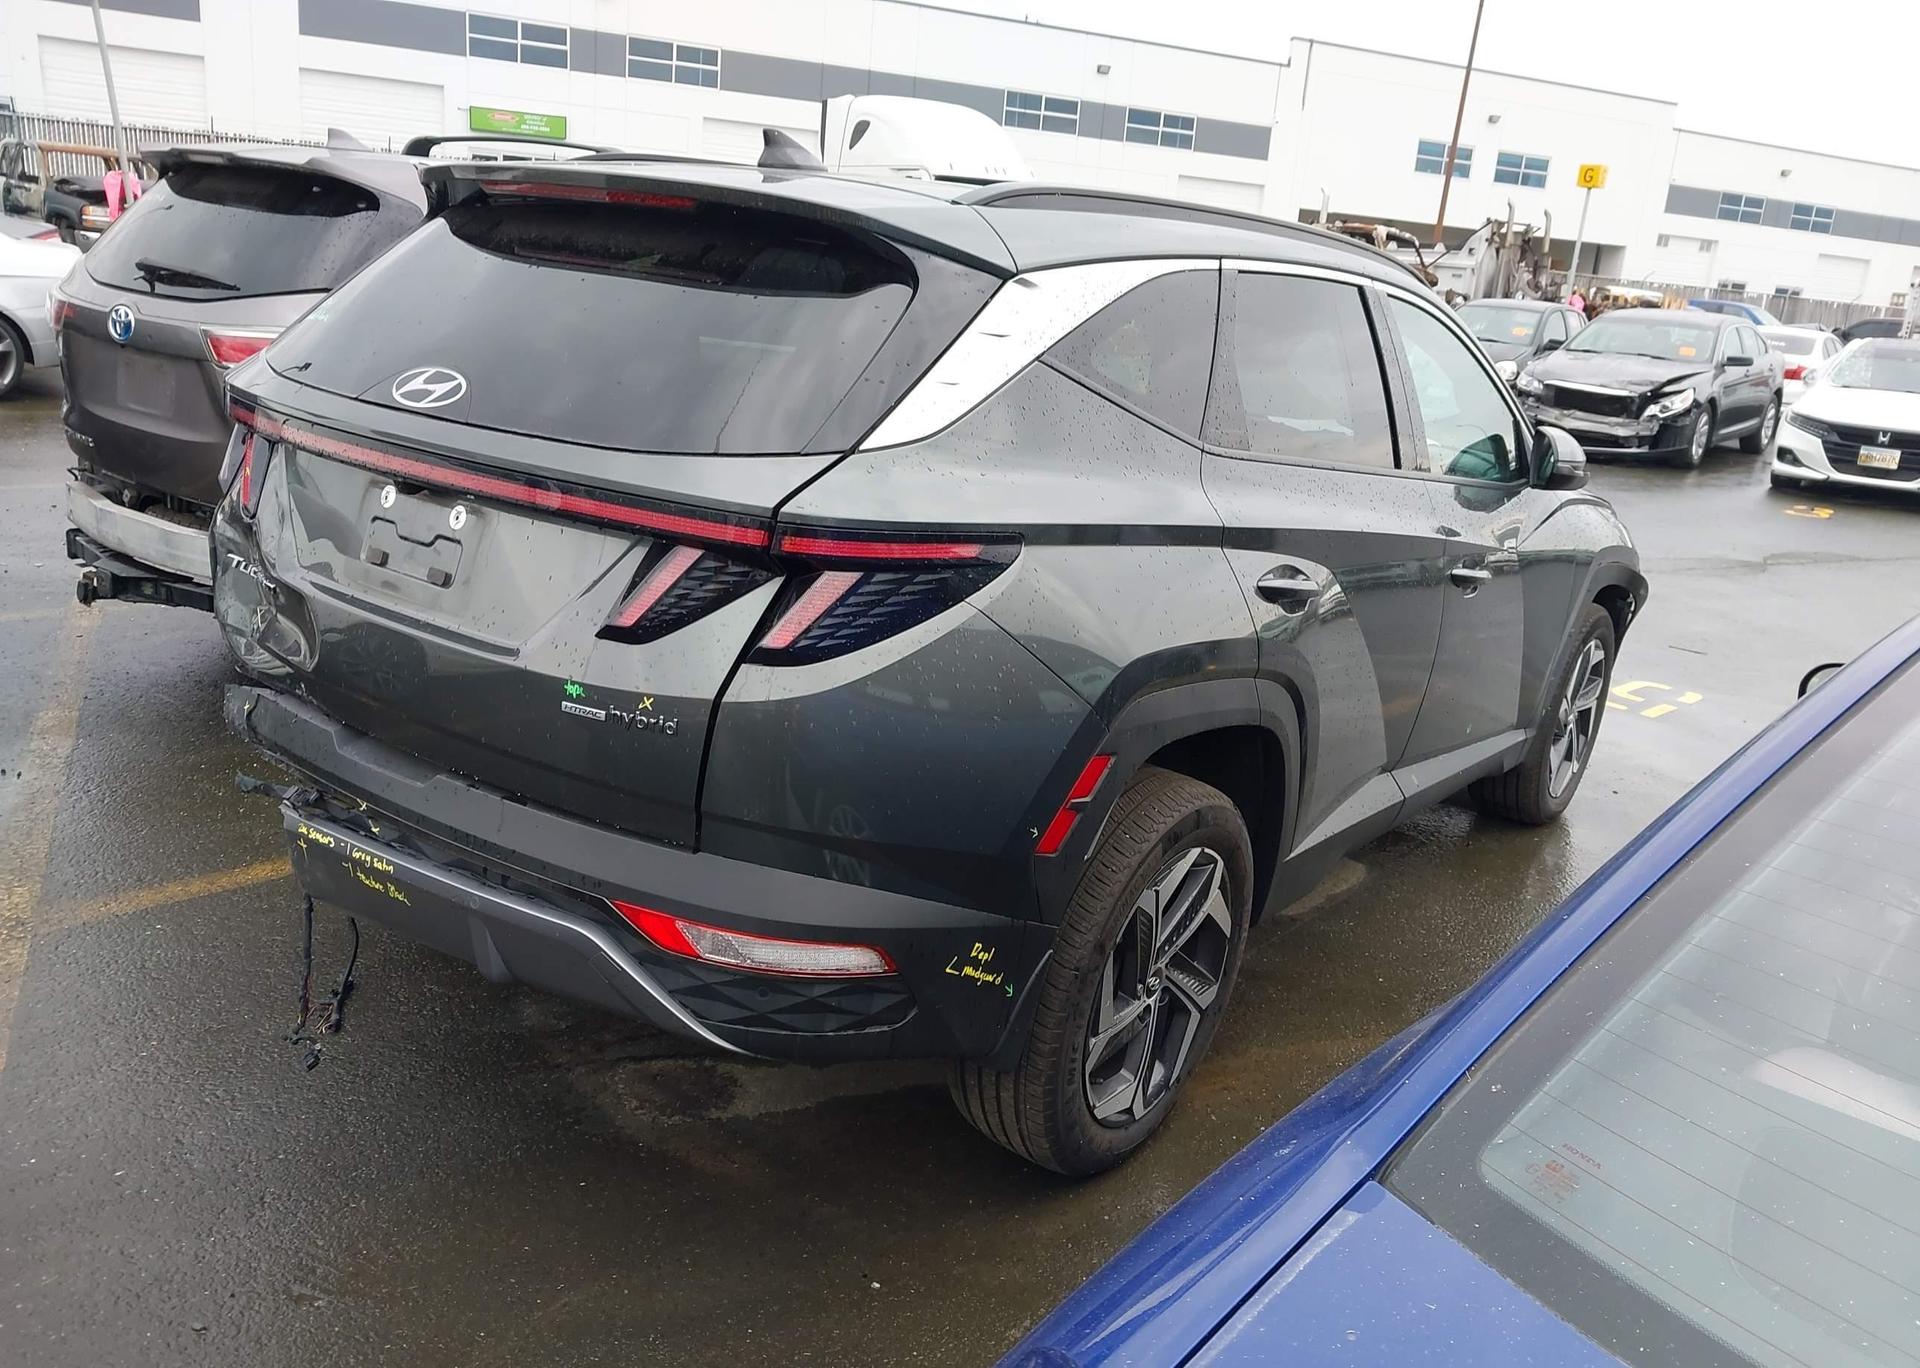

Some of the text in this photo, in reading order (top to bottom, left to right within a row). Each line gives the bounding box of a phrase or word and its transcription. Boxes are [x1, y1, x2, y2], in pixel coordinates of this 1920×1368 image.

[1583, 168, 1595, 183] G
[563, 703, 679, 735] HTRAC hybrid
